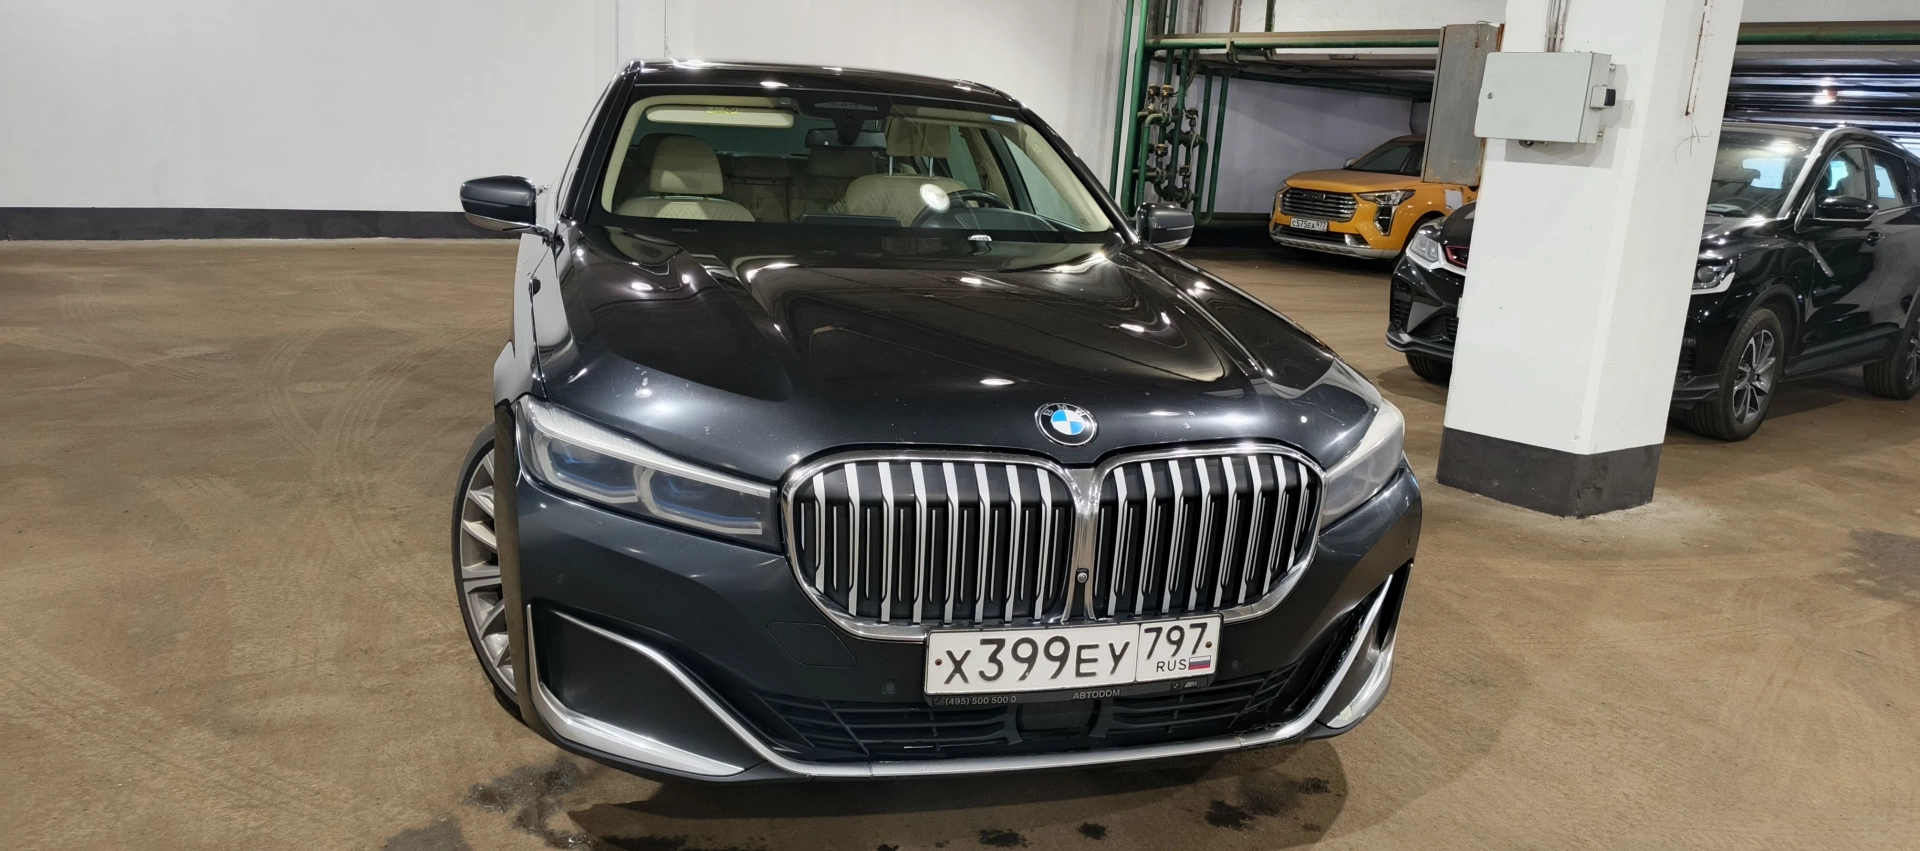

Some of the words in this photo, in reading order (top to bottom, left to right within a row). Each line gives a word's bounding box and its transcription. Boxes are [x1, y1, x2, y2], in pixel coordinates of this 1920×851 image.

[1043, 404, 1086, 417] BMW
[1144, 622, 1208, 660] 797
[1156, 659, 1187, 673] RUS
[945, 696, 970, 706] (495)
[971, 696, 990, 705] 500
[991, 696, 1009, 704] 500
